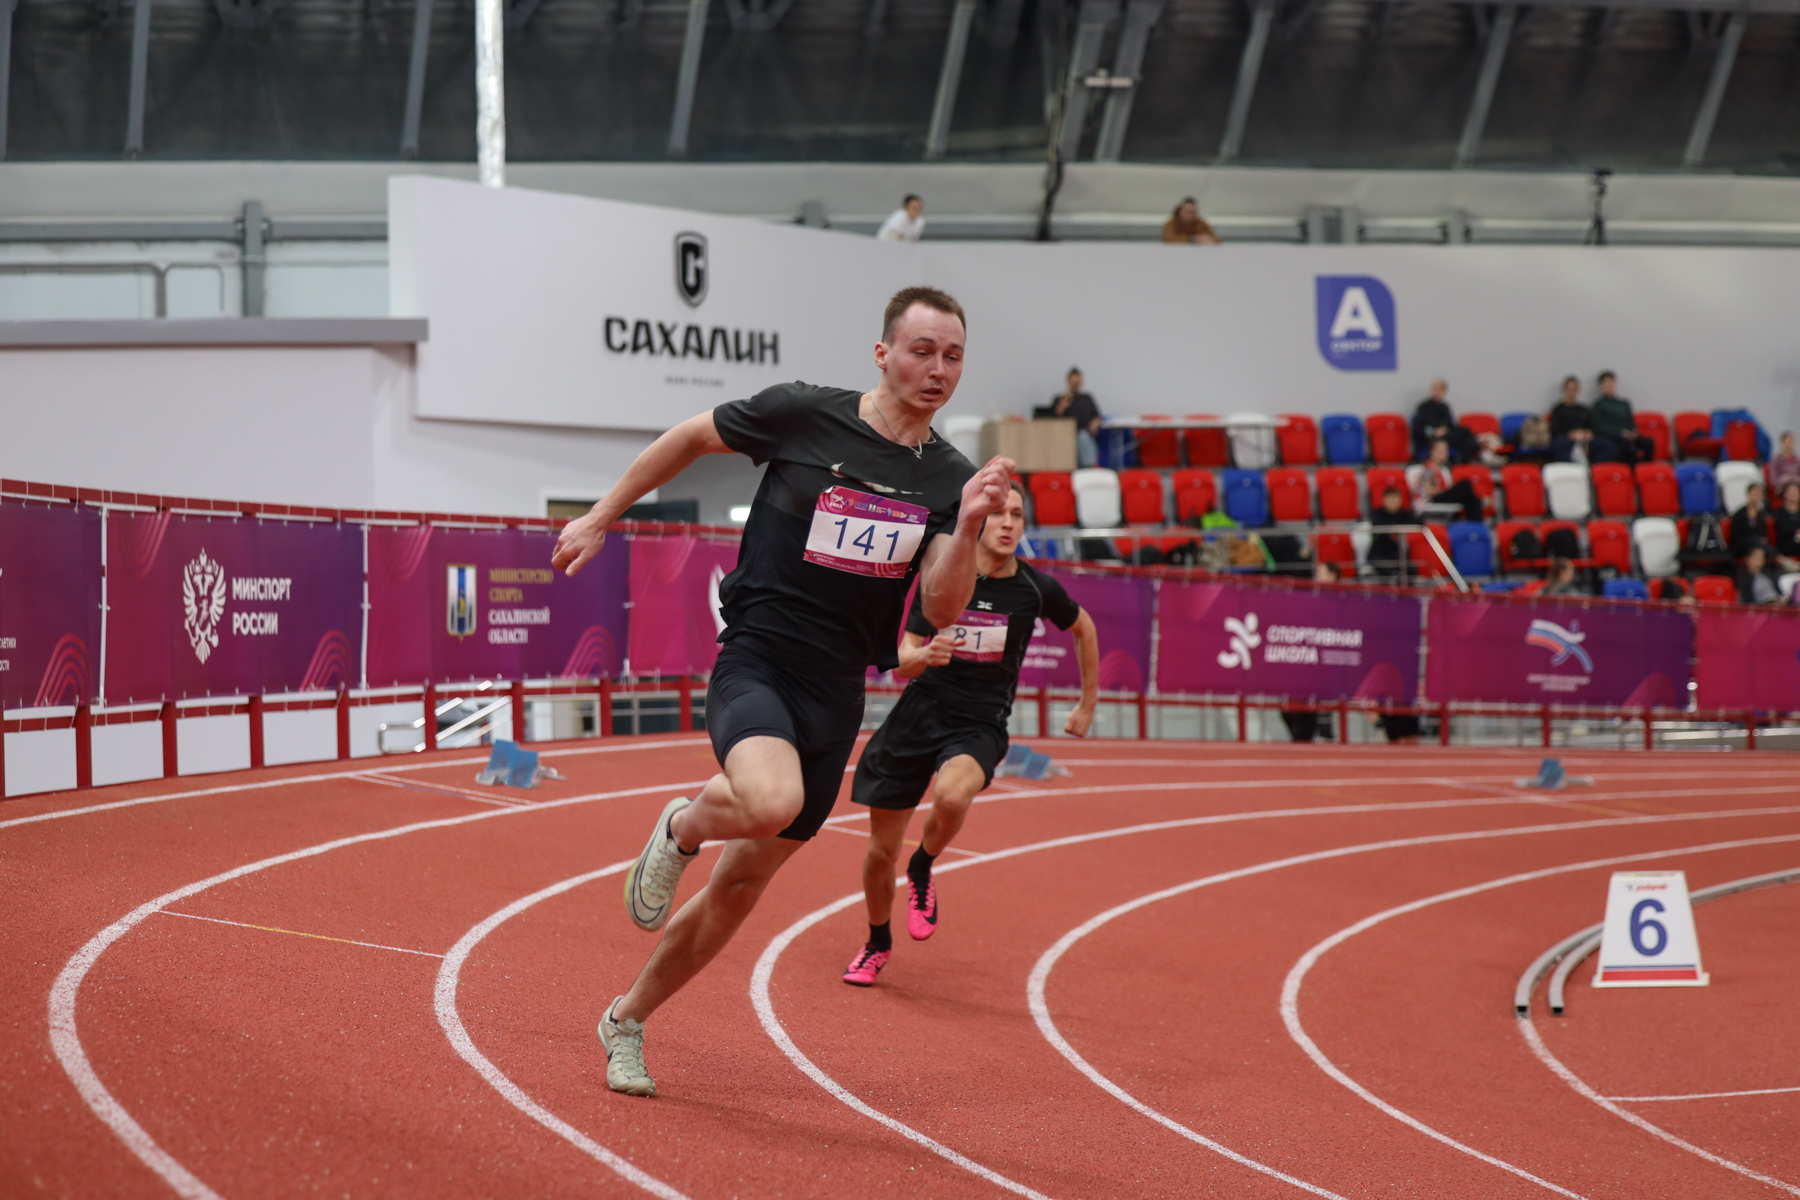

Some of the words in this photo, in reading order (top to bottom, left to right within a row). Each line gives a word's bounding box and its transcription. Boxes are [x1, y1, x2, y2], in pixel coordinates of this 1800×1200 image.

[1330, 286, 1383, 338] А
[604, 317, 780, 365] САХАЛИН
[834, 518, 900, 561] 141
[232, 577, 292, 601] МИНСПОРТ
[488, 587, 524, 603] СПОРТА
[232, 612, 279, 636] РОССИИ
[487, 606, 551, 626] САХАЛИНСКОЙ
[487, 627, 529, 645] ОБЛАСТИ
[1266, 624, 1364, 648] СПОРТИВНАЯ
[1264, 643, 1319, 665] ШКОЛА
[1630, 898, 1668, 957] 6
